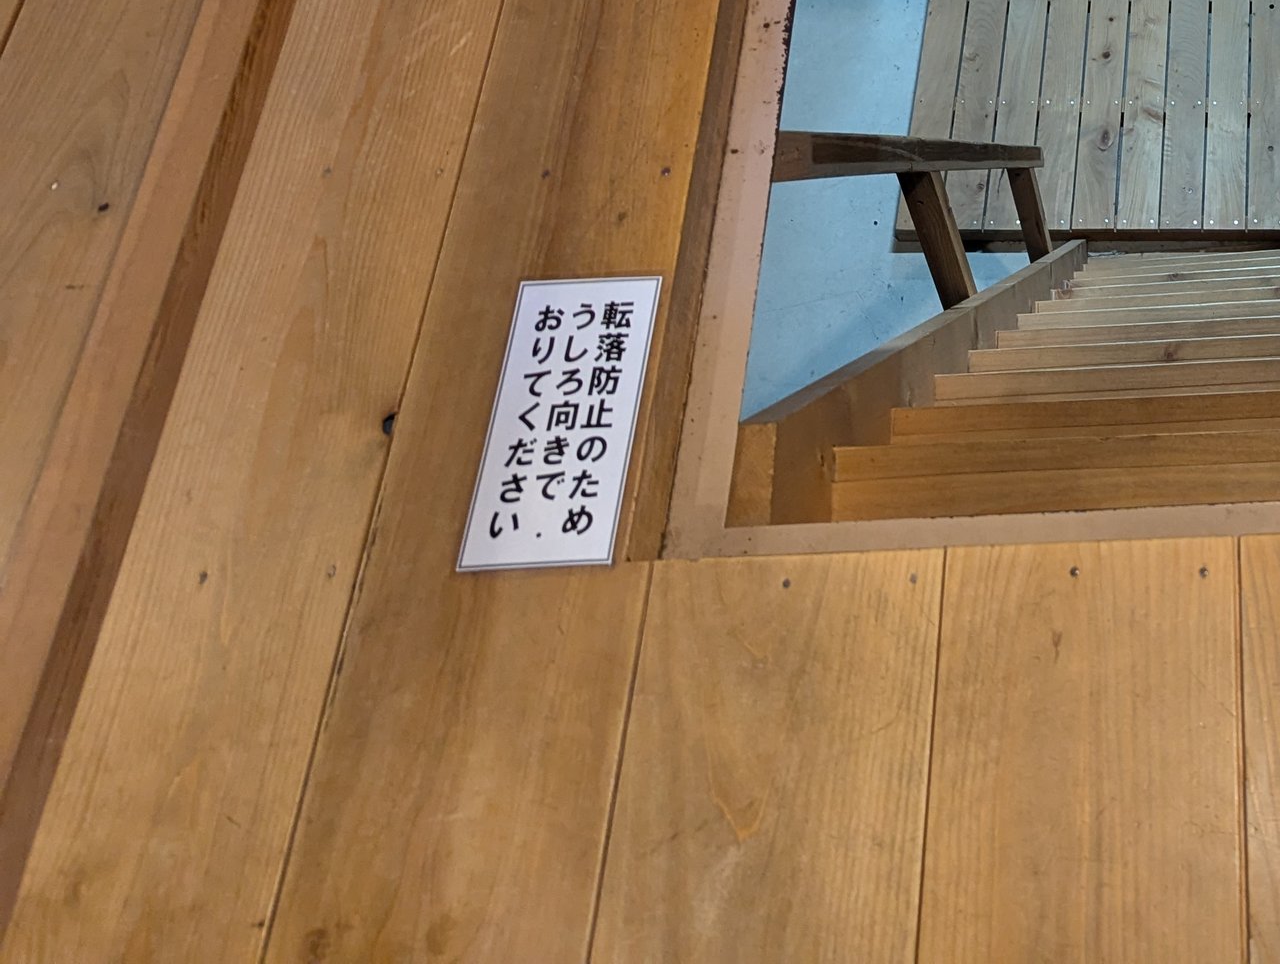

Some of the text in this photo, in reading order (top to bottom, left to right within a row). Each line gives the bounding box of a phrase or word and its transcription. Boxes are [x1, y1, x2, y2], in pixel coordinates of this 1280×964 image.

[489, 304, 565, 539] おりてください
[561, 301, 634, 536] 転落防止のため
